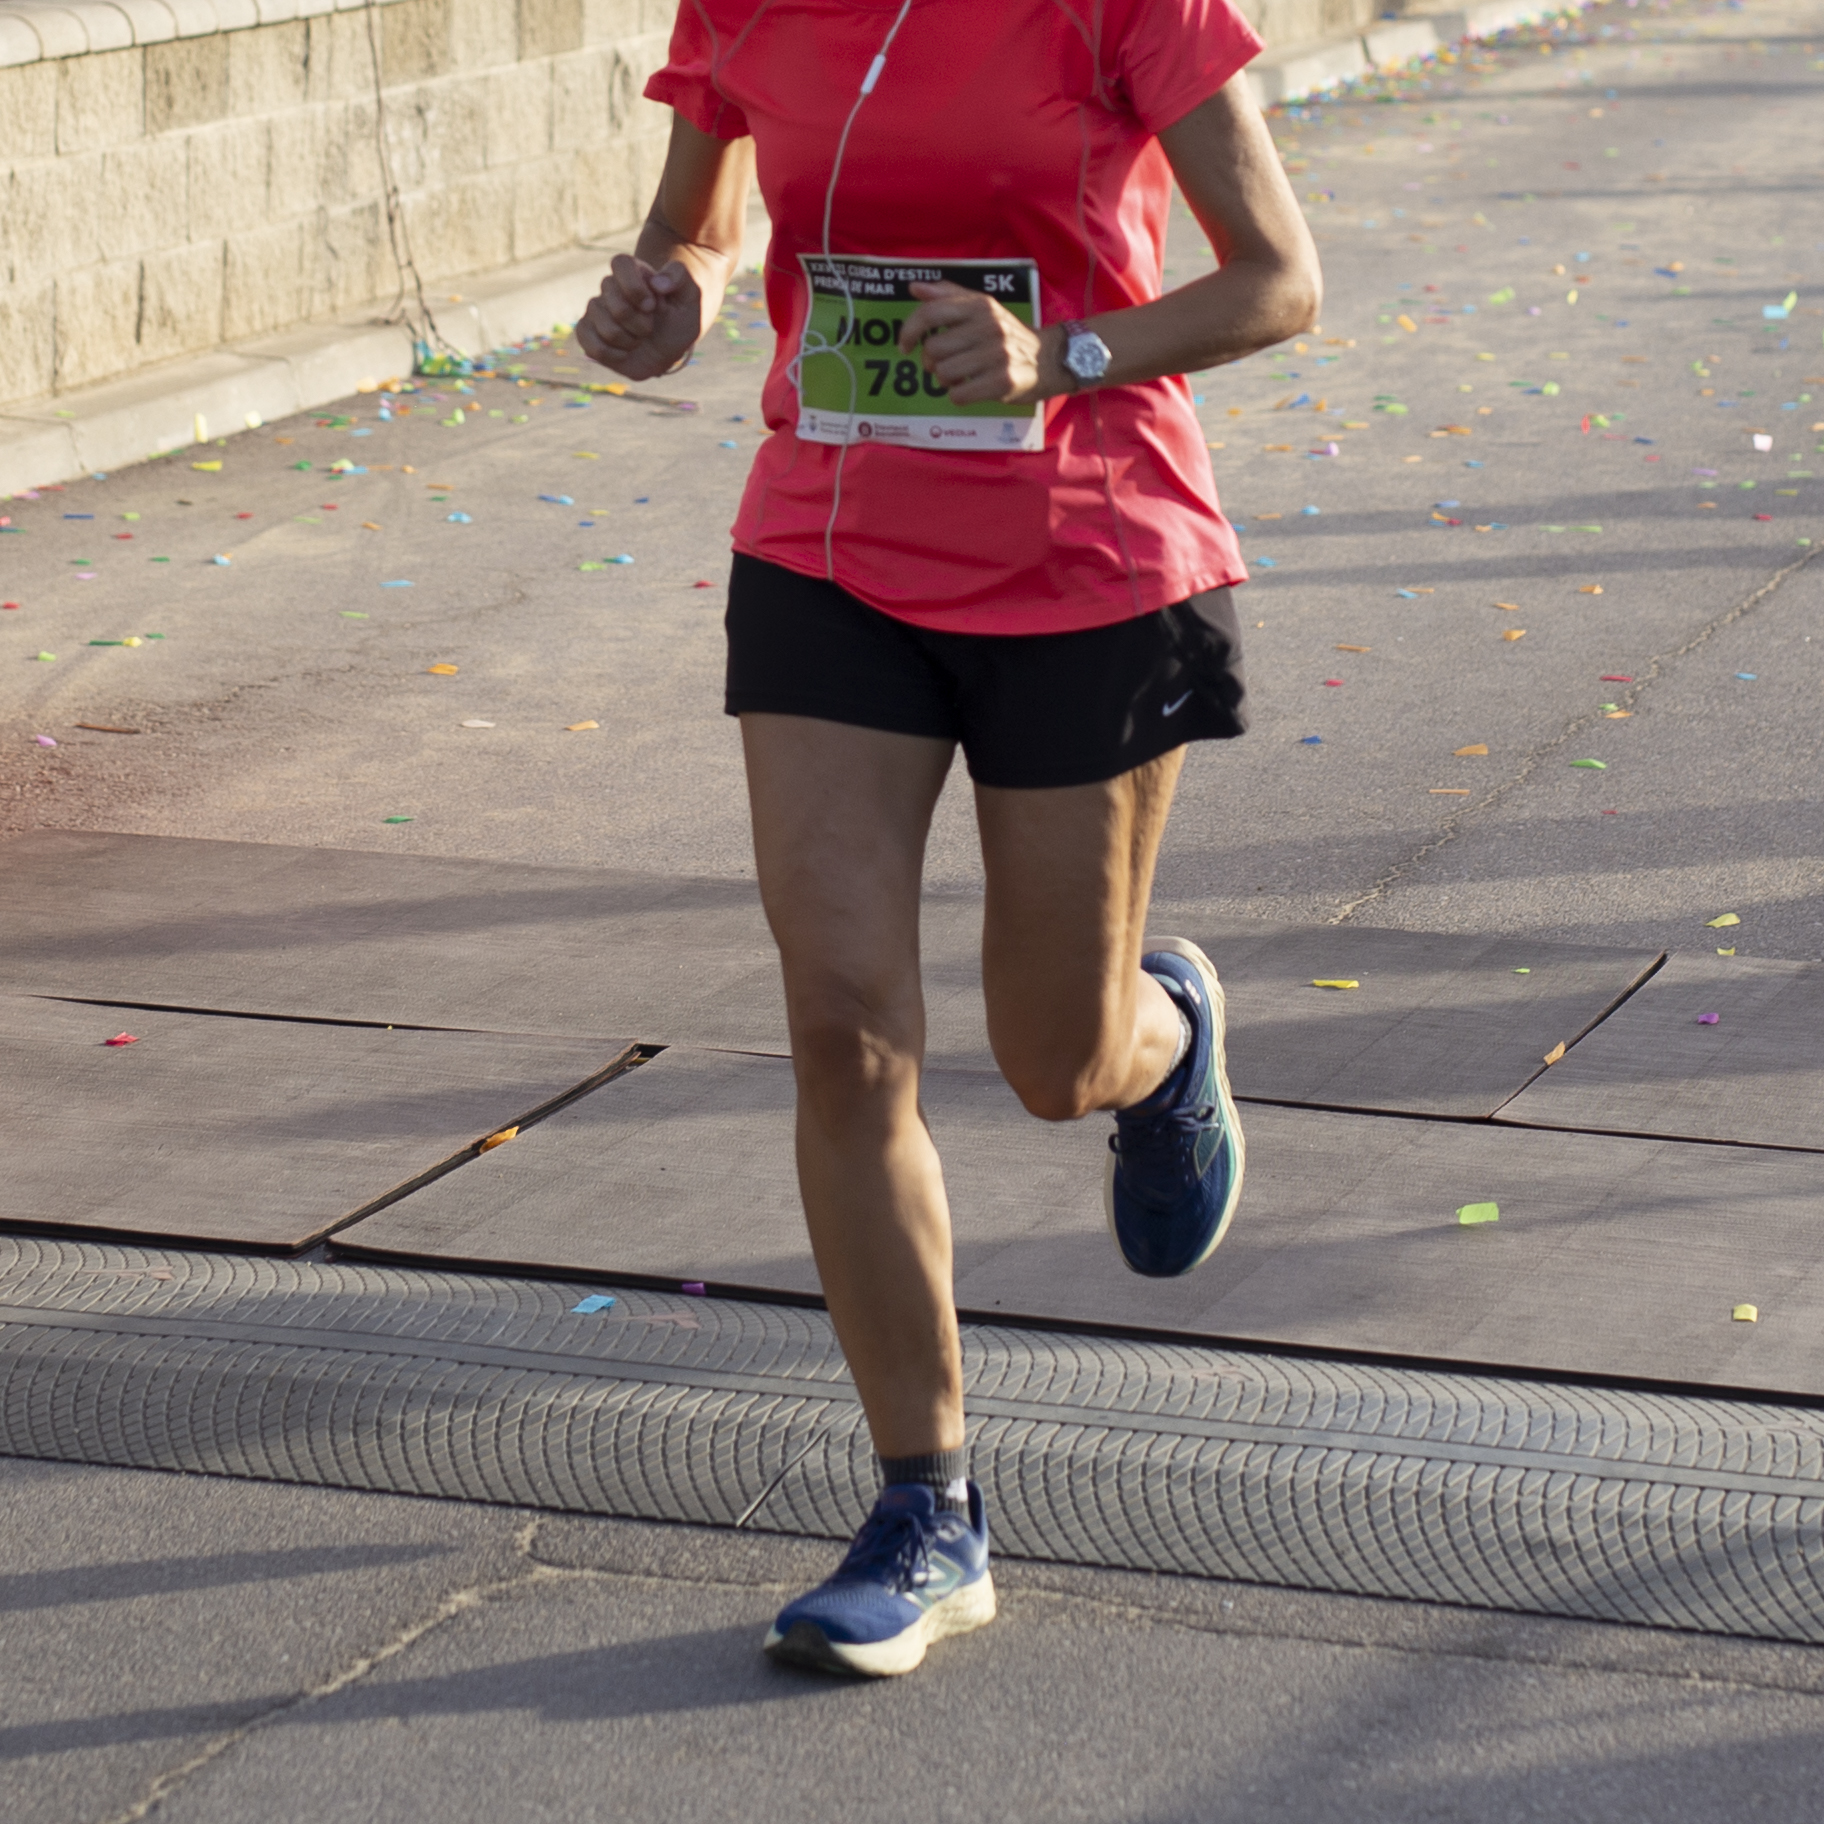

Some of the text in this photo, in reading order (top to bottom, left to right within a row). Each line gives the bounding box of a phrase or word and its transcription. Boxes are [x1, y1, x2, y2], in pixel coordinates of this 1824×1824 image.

[848, 265, 881, 280] CURSA
[883, 268, 944, 282] D'ESTIU
[864, 282, 895, 296] MAR
[983, 274, 1015, 293] 5K
